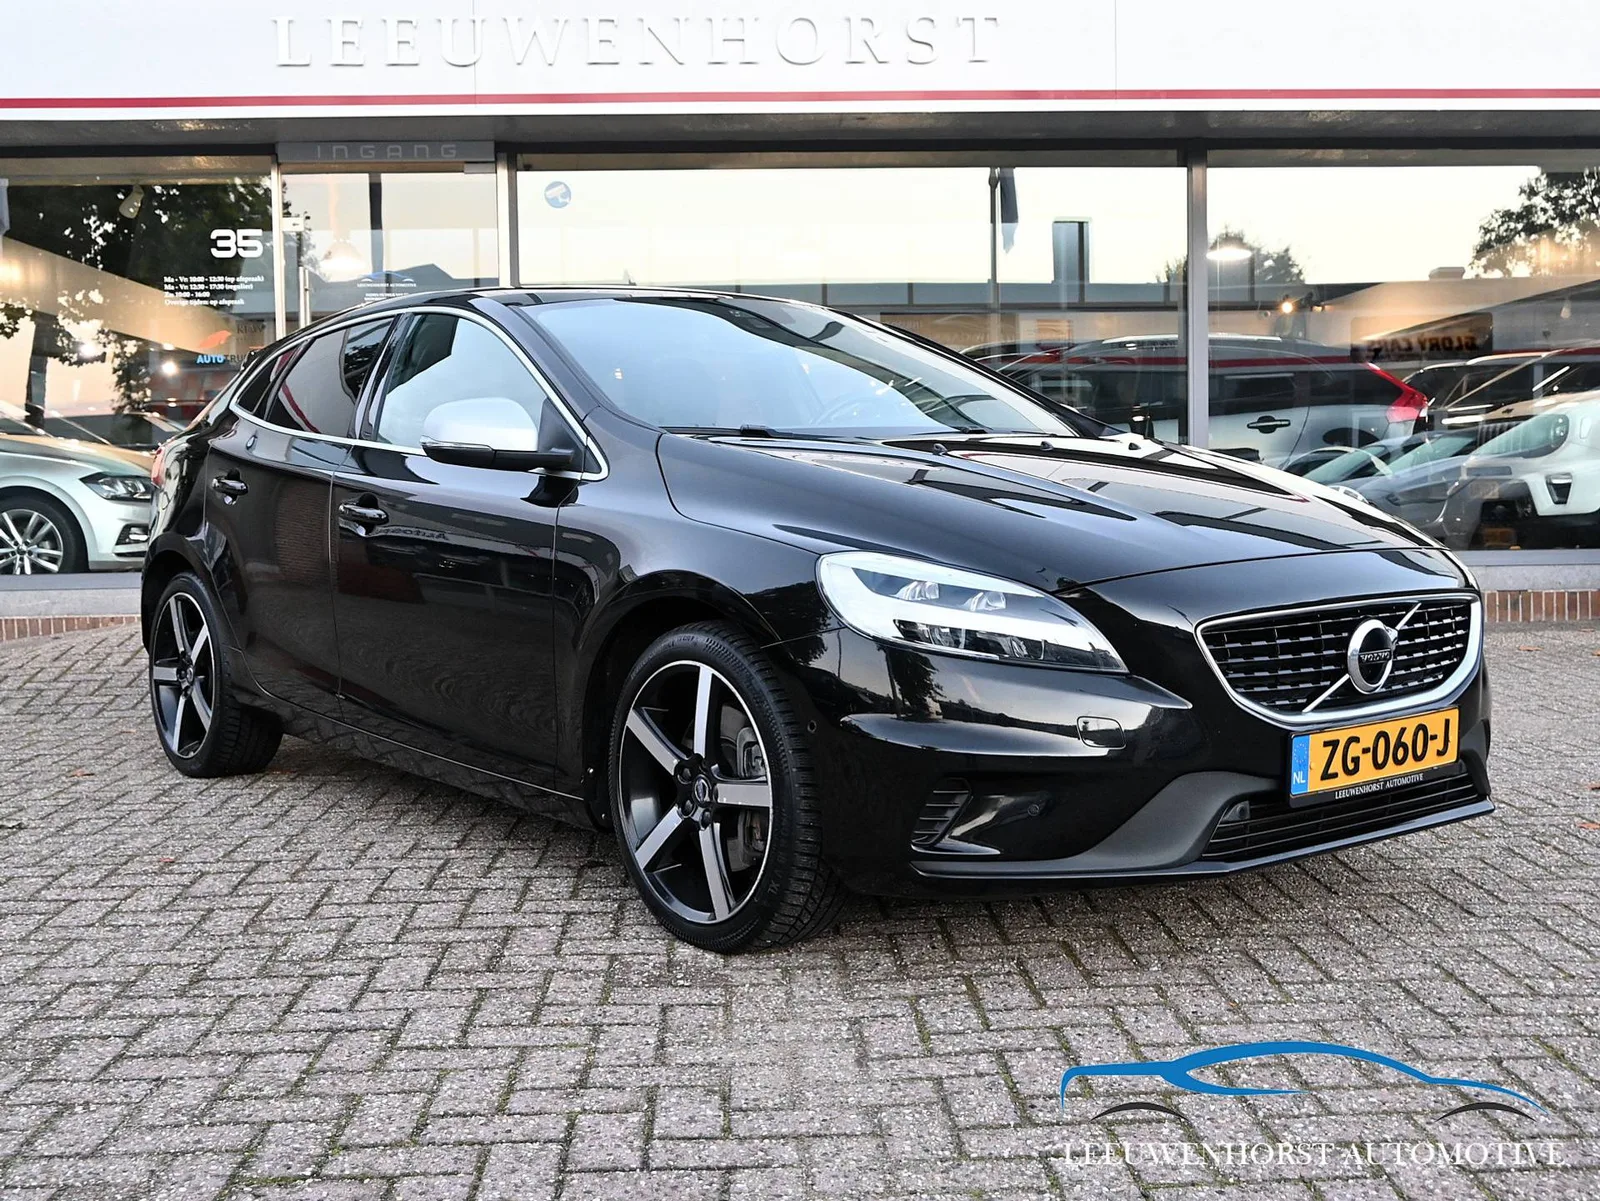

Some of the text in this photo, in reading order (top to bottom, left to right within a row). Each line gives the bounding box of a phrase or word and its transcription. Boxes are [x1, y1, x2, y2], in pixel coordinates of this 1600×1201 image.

[270, 15, 998, 68] LEEUWENHORST
[210, 228, 264, 258] 35
[218, 298, 245, 307] afspraak
[1320, 718, 1451, 781] ZG-060-J
[1292, 770, 1306, 785] NL
[1334, 773, 1424, 800] LEEUWENHORST AUTOMOTIVE
